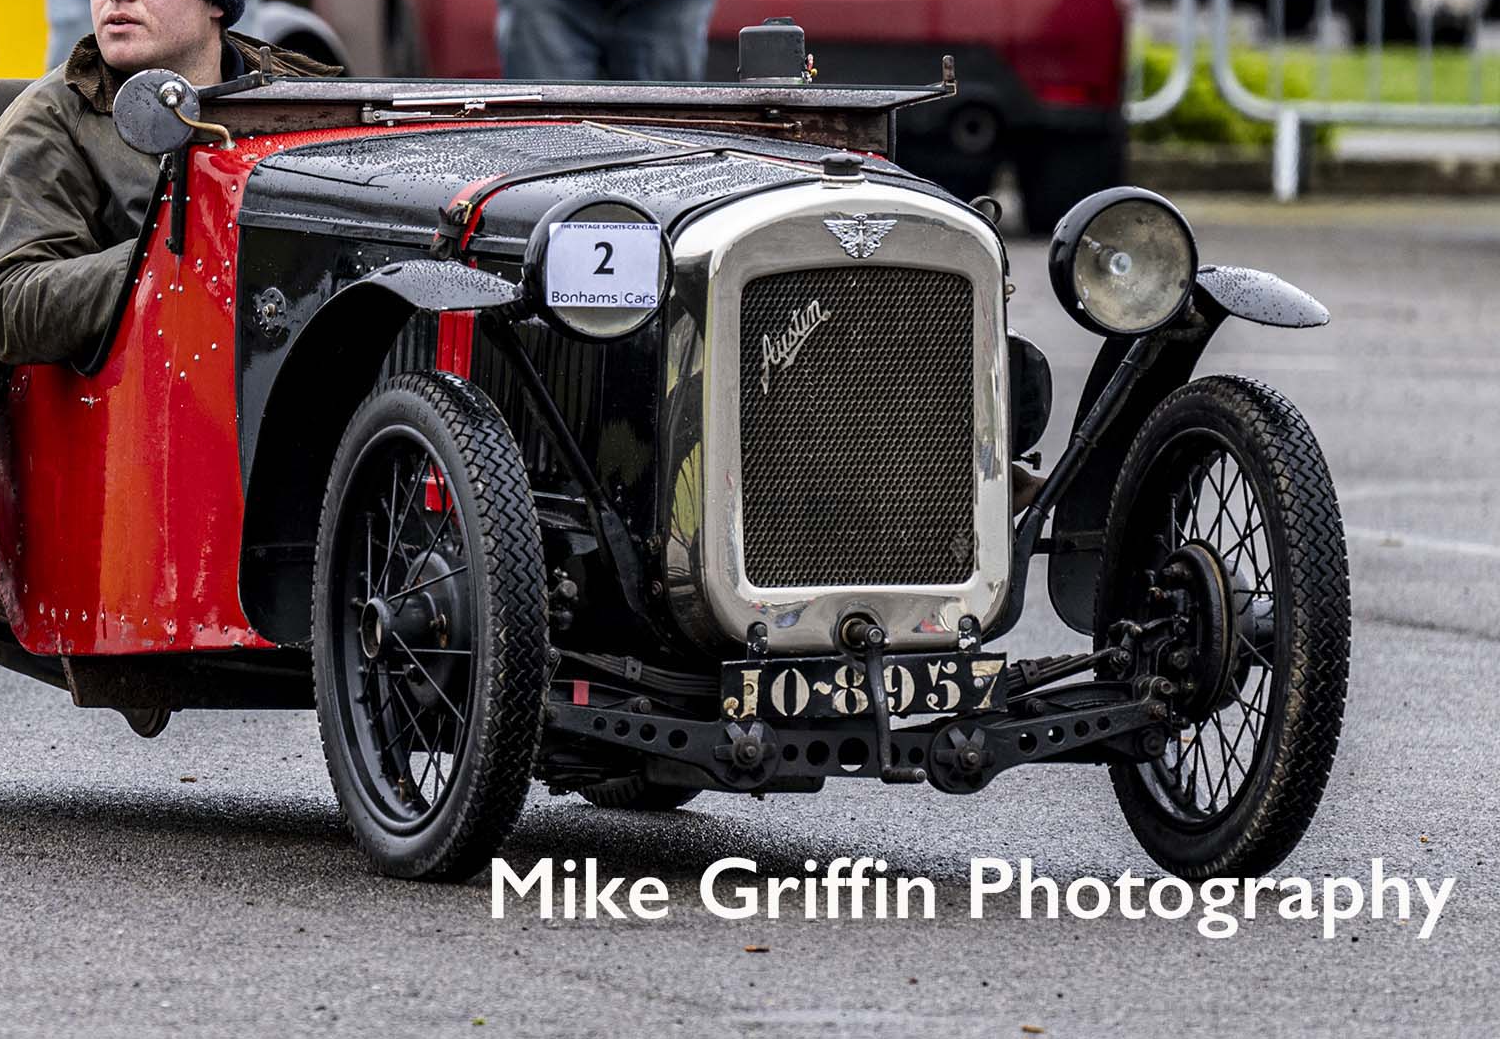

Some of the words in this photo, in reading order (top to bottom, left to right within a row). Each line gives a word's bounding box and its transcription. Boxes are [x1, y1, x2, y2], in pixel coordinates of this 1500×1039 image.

[593, 241, 615, 276] 2
[551, 291, 618, 304] Bonhams
[624, 292, 656, 305] Cars
[761, 300, 831, 394] Austin
